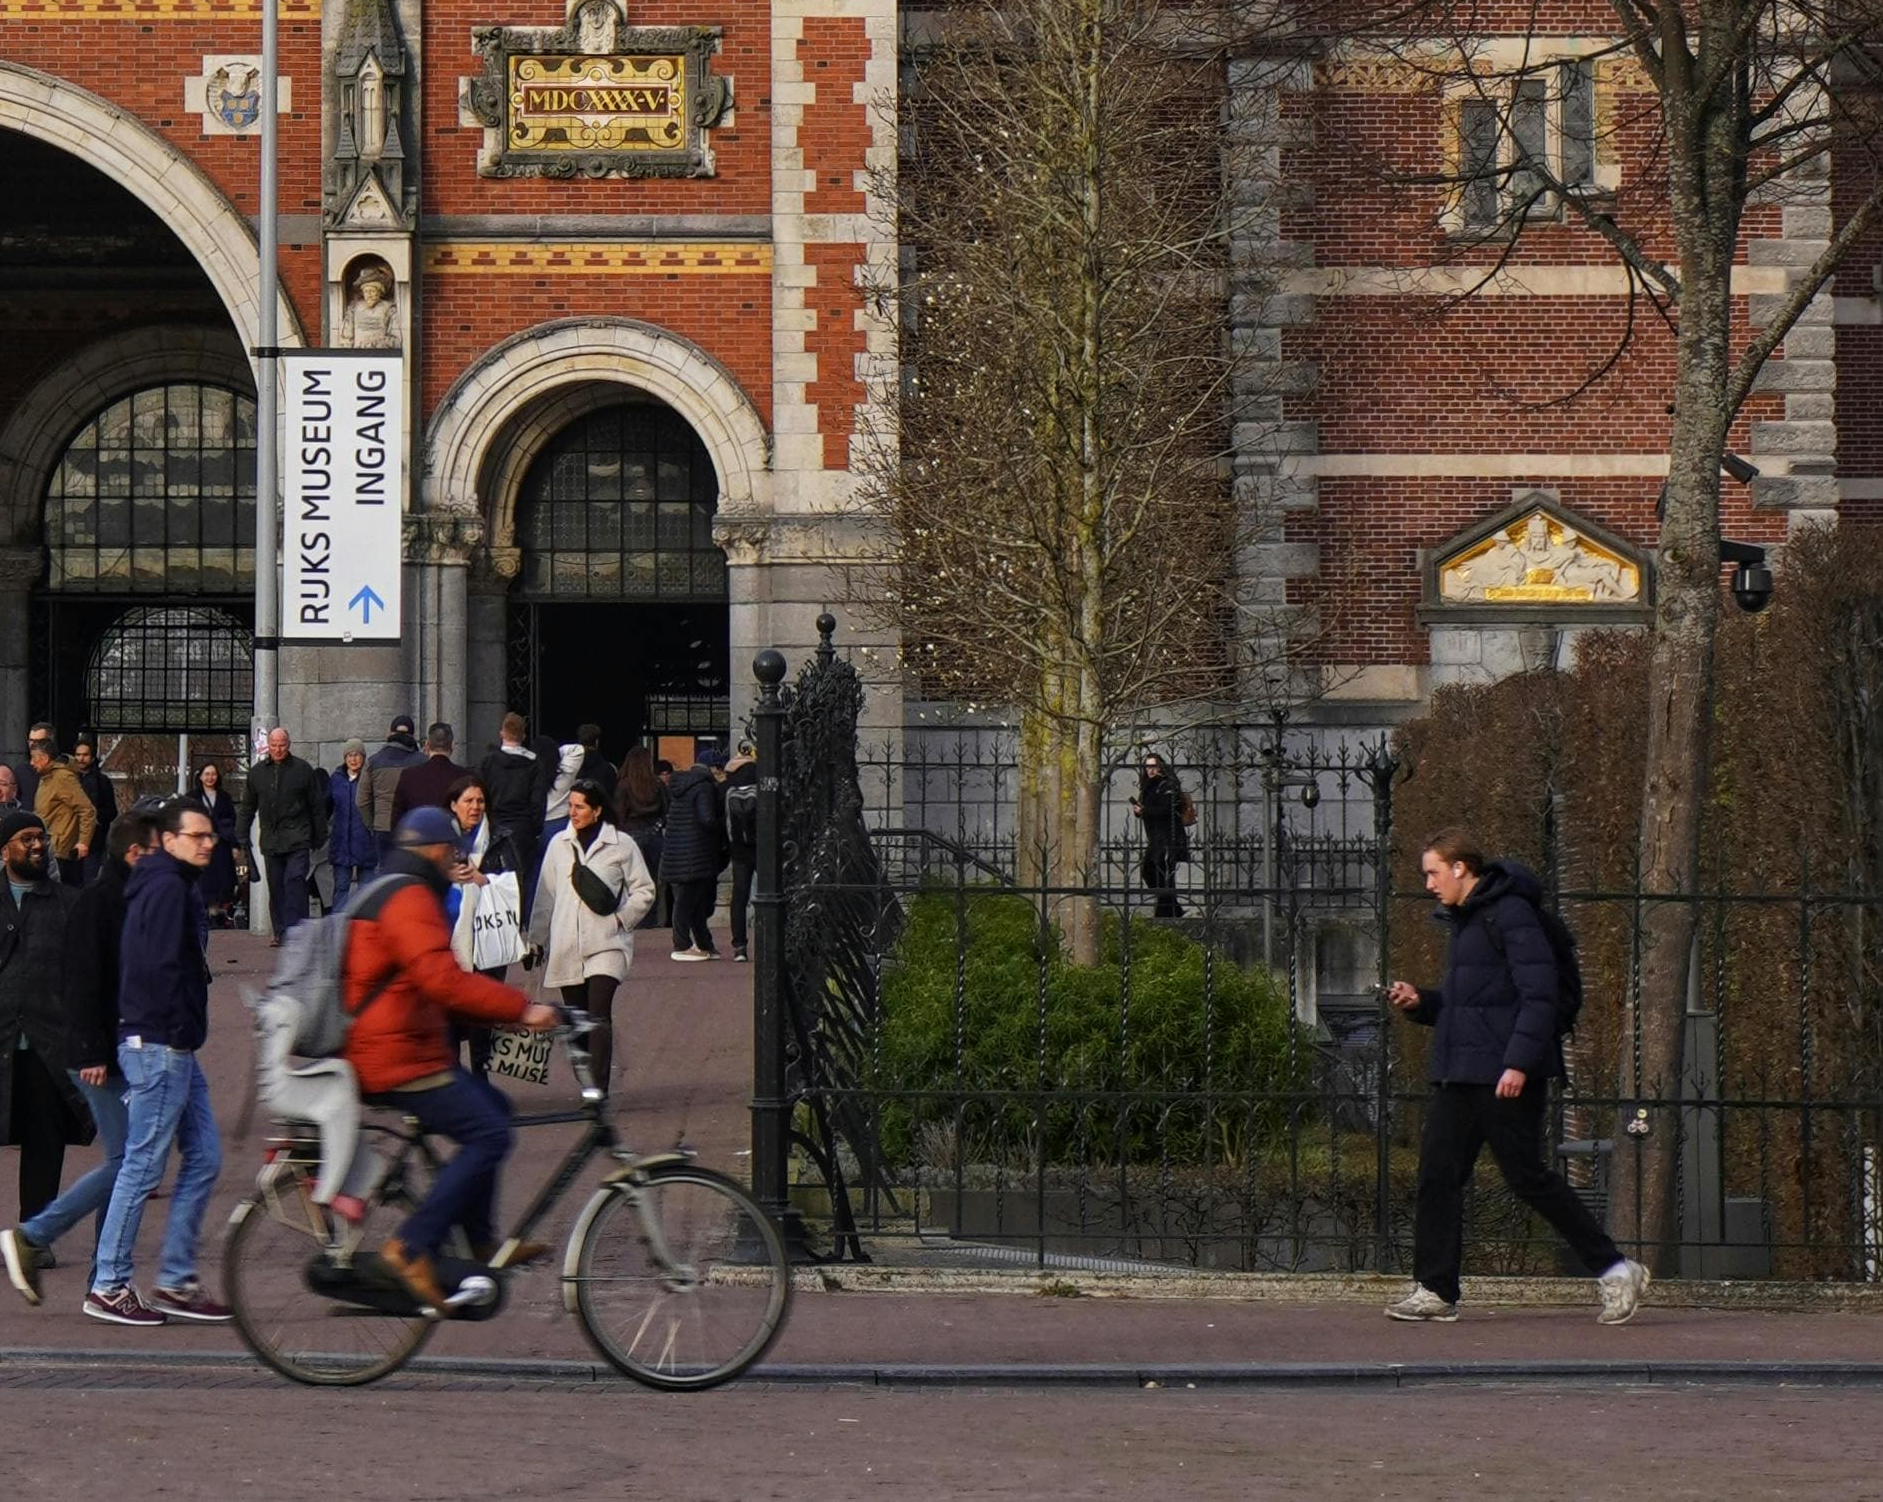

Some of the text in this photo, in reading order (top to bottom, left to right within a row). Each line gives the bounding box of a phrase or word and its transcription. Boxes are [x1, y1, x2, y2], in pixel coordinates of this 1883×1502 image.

[300, 369, 332, 624] RIJKS MUSEUM
[355, 369, 386, 505] INGANG
